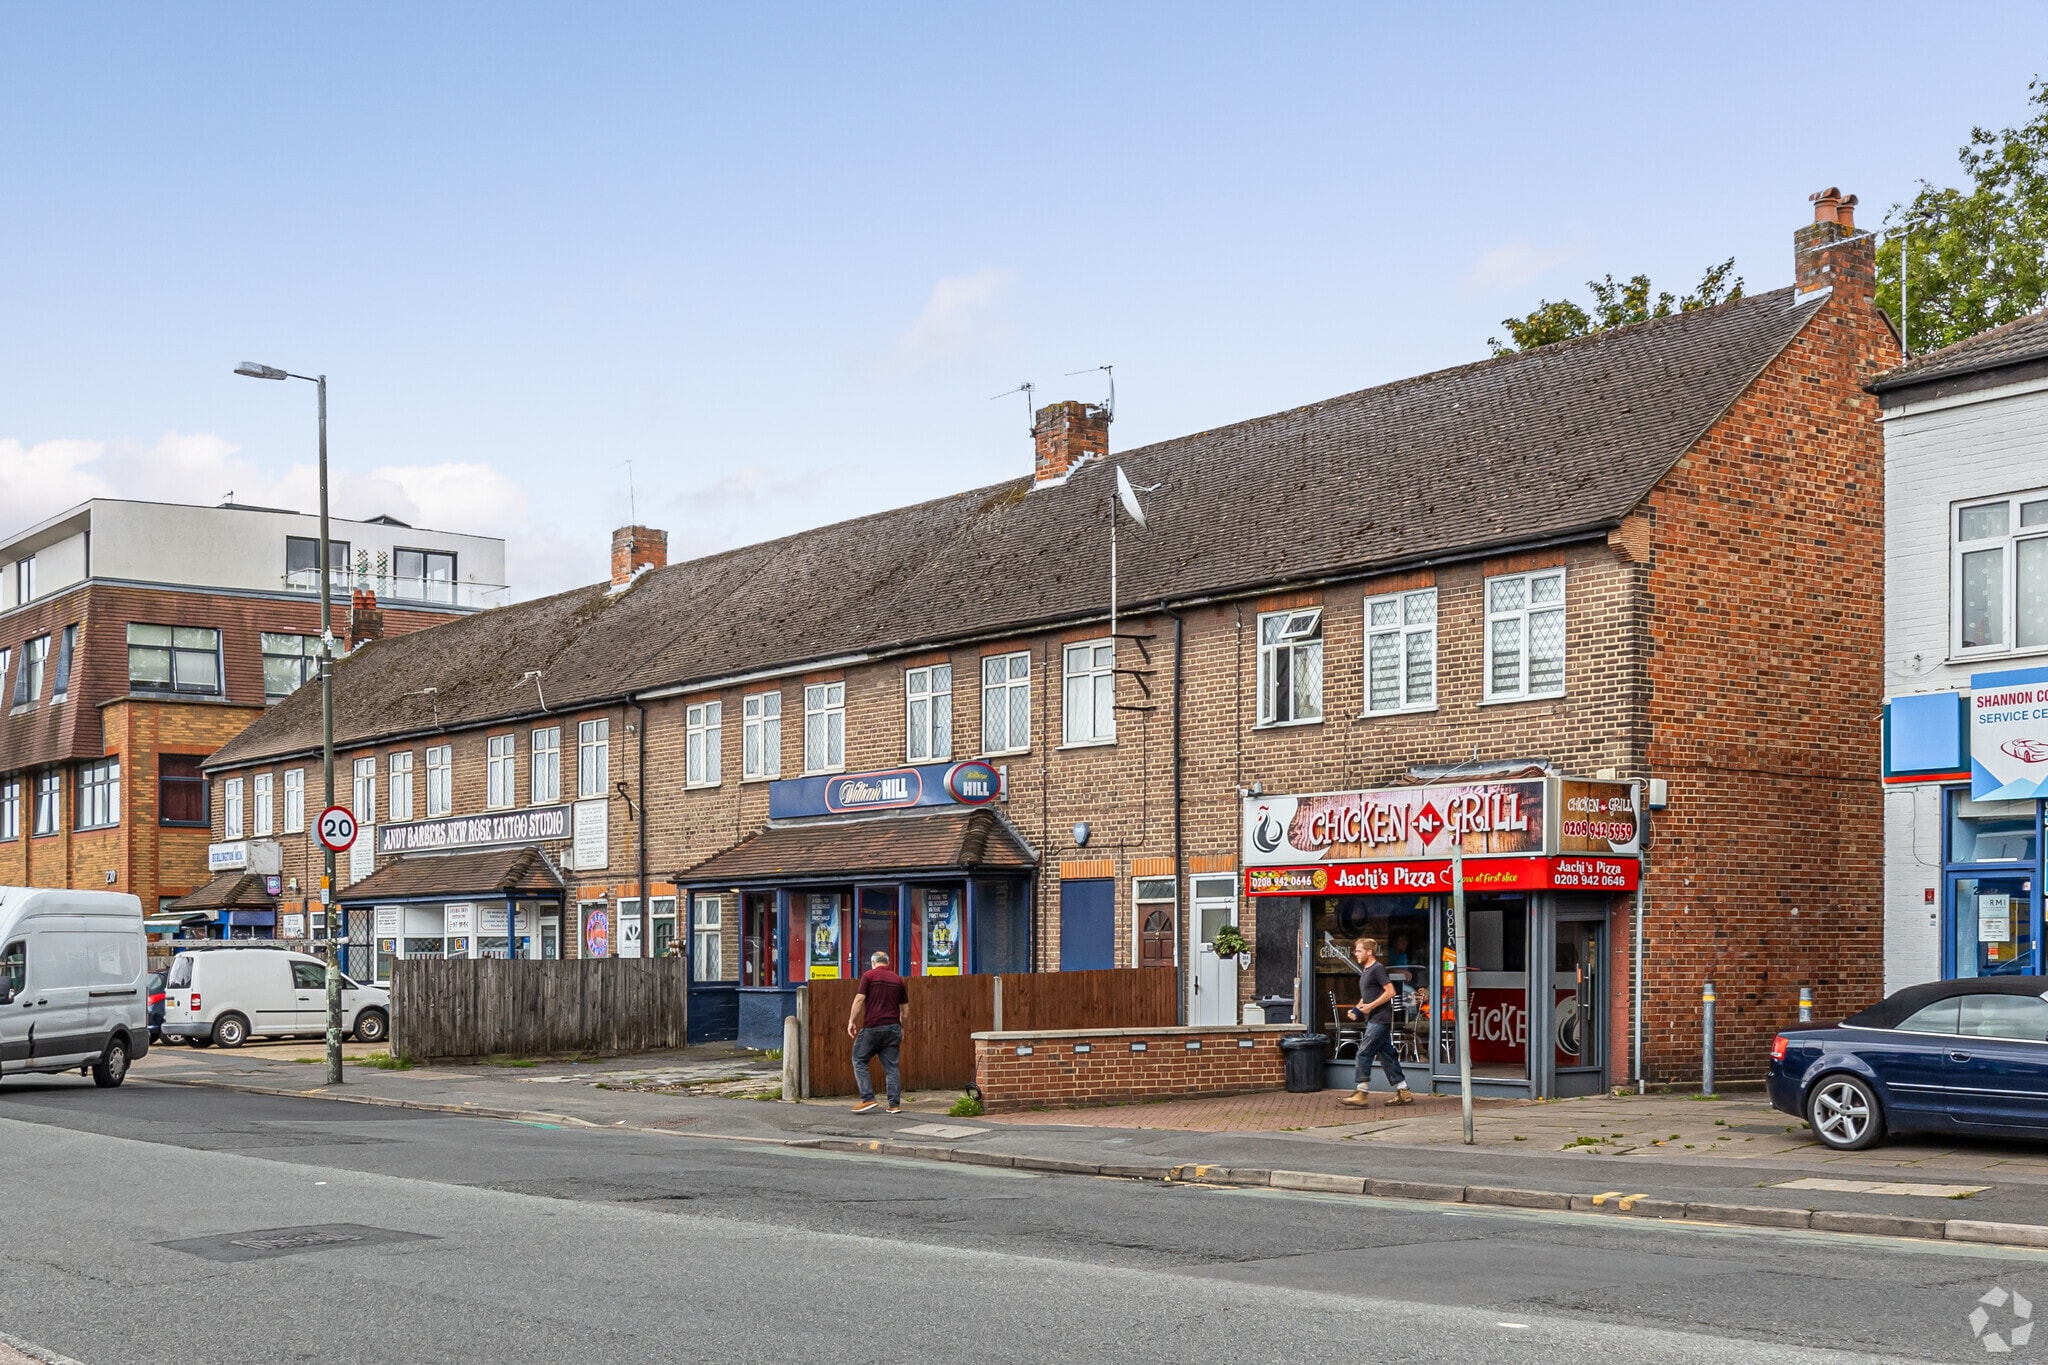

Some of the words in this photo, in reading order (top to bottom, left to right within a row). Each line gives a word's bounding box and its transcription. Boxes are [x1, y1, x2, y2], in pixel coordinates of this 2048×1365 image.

[1976, 691, 2033, 709] SHANNON
[1979, 710, 2029, 725] SERVICE
[839, 780, 882, 806] William
[882, 778, 908, 800] HILL
[963, 781, 990, 796] HILL
[1567, 797, 1600, 815] CHICKEN
[1608, 797, 1634, 816] GRILL
[324, 819, 352, 838] 20
[1308, 799, 1411, 848] CHICKEN
[1443, 791, 1531, 846] GRILL
[383, 828, 407, 850] ANDY
[407, 824, 446, 849] BARBERS
[447, 821, 468, 844] NEW
[468, 819, 492, 842] ROSE
[493, 814, 528, 840] TATTOO
[529, 810, 564, 837] STUDIO
[1563, 819, 1588, 837] 0208
[1589, 821, 1607, 839] 942
[1608, 821, 1633, 841] 5959
[1556, 860, 1593, 875] Aachi's
[1596, 860, 1622, 874] Pizza
[1252, 875, 1272, 887] 0208
[1273, 875, 1289, 887] 942
[1291, 874, 1312, 886] 0646
[1334, 868, 1388, 890] Aachi's
[1393, 866, 1436, 887] Pizza
[1554, 875, 1579, 885] 0208
[1581, 875, 1599, 885] 942
[1601, 875, 1625, 886] 0646
[1467, 1003, 1527, 1047] HICKE
